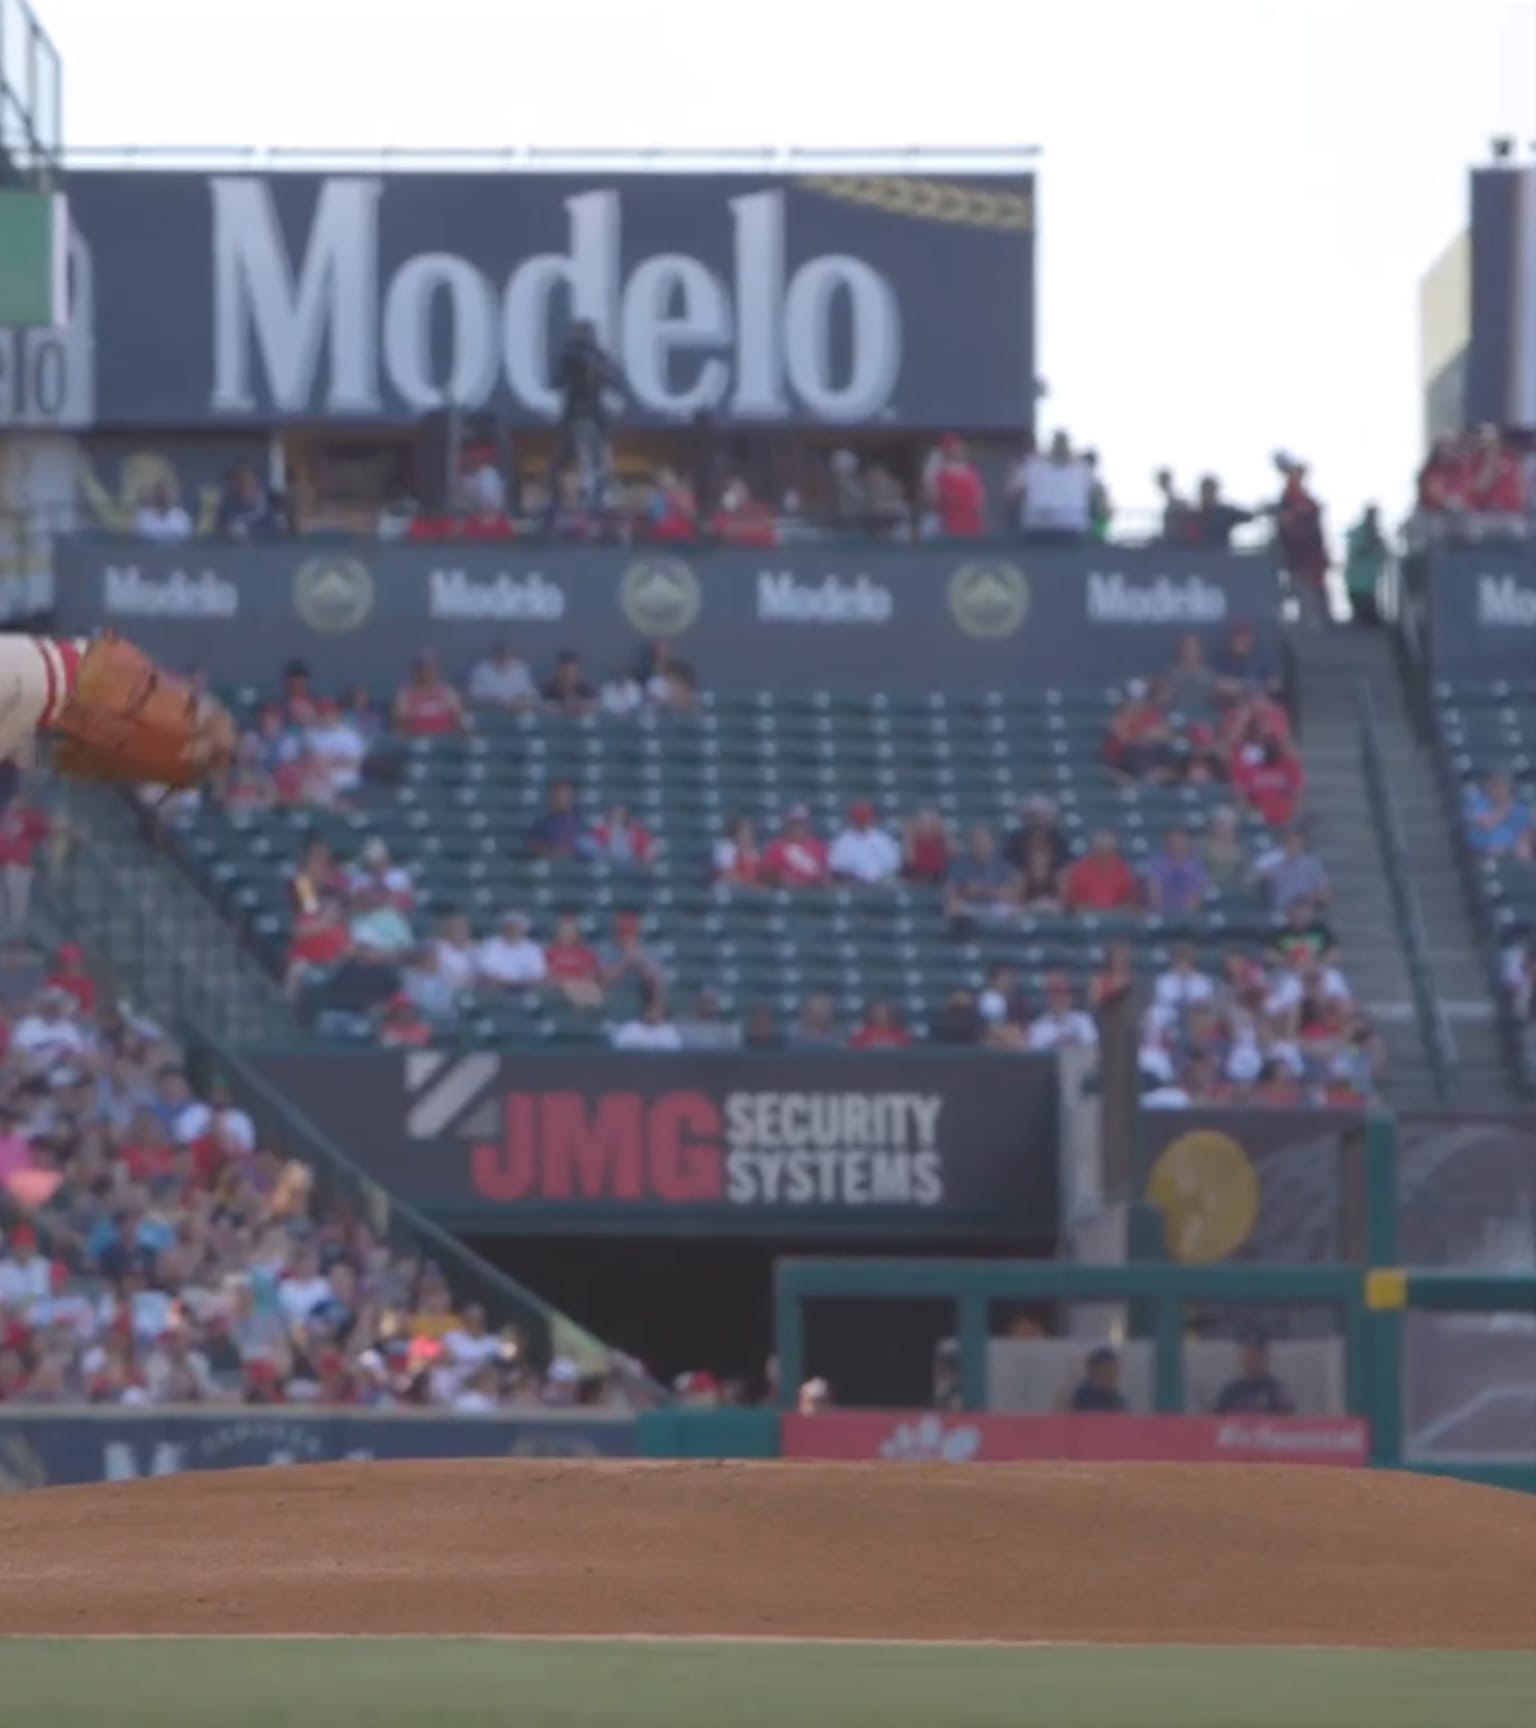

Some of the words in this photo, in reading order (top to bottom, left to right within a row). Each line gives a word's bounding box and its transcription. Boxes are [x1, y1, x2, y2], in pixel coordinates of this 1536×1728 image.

[208, 175, 902, 421] Modelo
[104, 565, 239, 618] Modelo
[430, 568, 564, 620] Modelo
[757, 569, 892, 622] Modelo
[1087, 570, 1227, 623] Modelo
[471, 1090, 721, 1201] JMG
[725, 1092, 942, 1148] SECURITY
[726, 1151, 943, 1206] SYSTEMS
